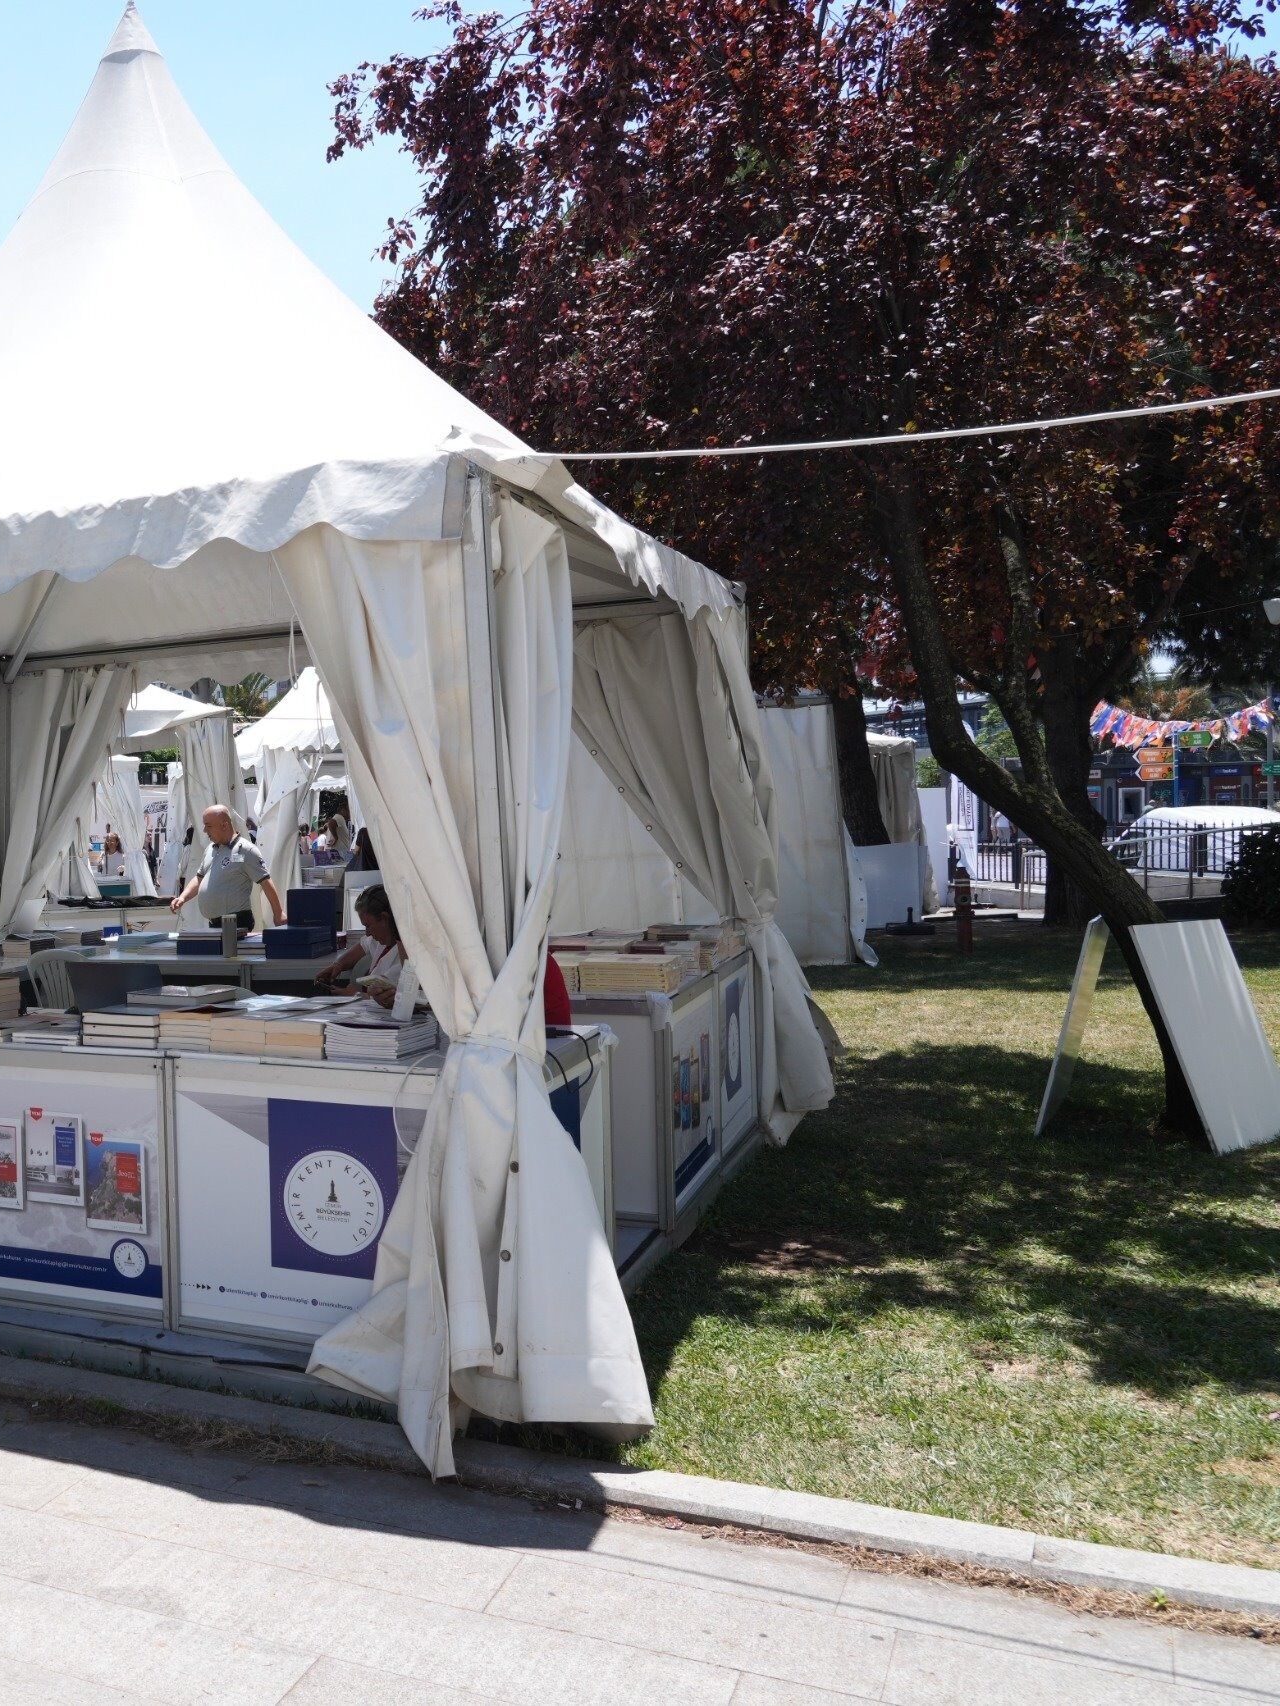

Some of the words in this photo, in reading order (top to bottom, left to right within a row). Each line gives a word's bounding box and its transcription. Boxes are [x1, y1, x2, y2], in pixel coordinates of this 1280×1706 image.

[297, 1159, 333, 1183] KENT
[291, 1192, 318, 1240] İZMİR
[343, 1164, 375, 1243] KİTAPLIĞI
